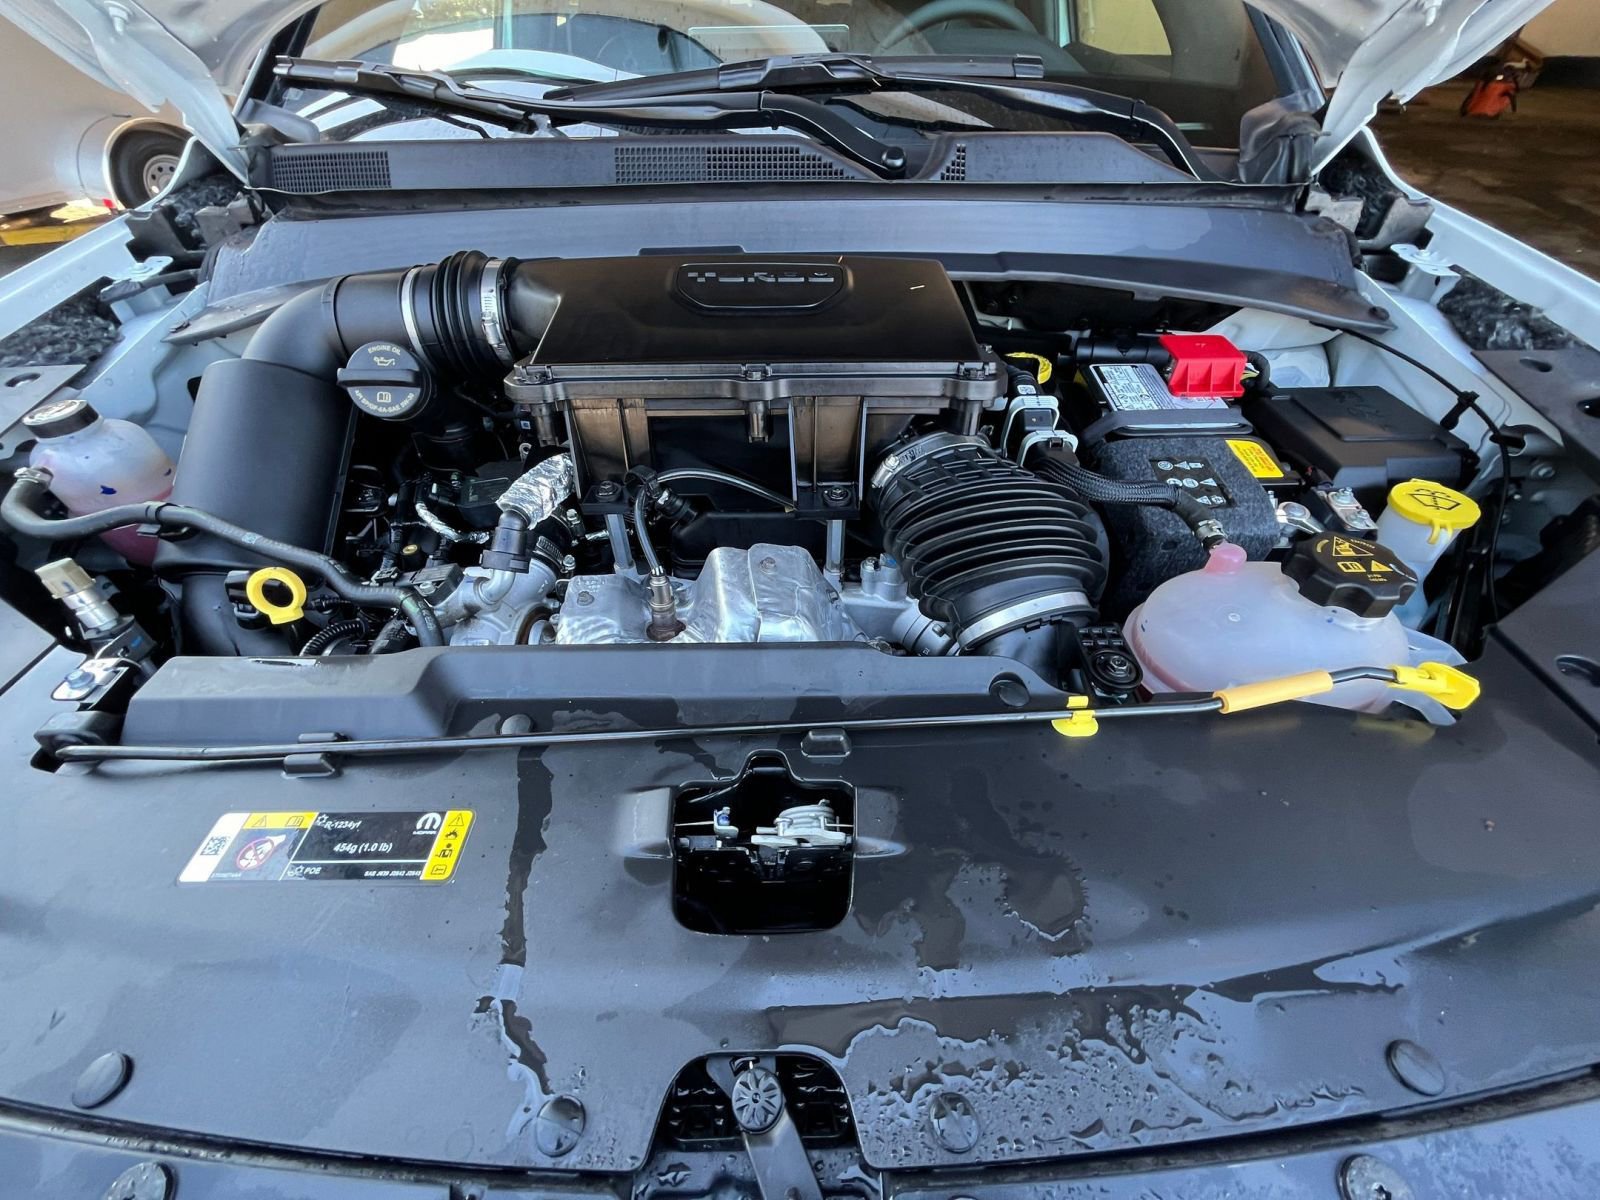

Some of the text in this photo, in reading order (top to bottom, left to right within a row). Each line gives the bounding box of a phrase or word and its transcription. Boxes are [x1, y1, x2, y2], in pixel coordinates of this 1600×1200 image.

[367, 345, 401, 356] ENGINE OIL
[323, 820, 362, 831] R-1234yf
[333, 842, 393, 854] 454g (1.0 lb)
[303, 866, 322, 875] POE
